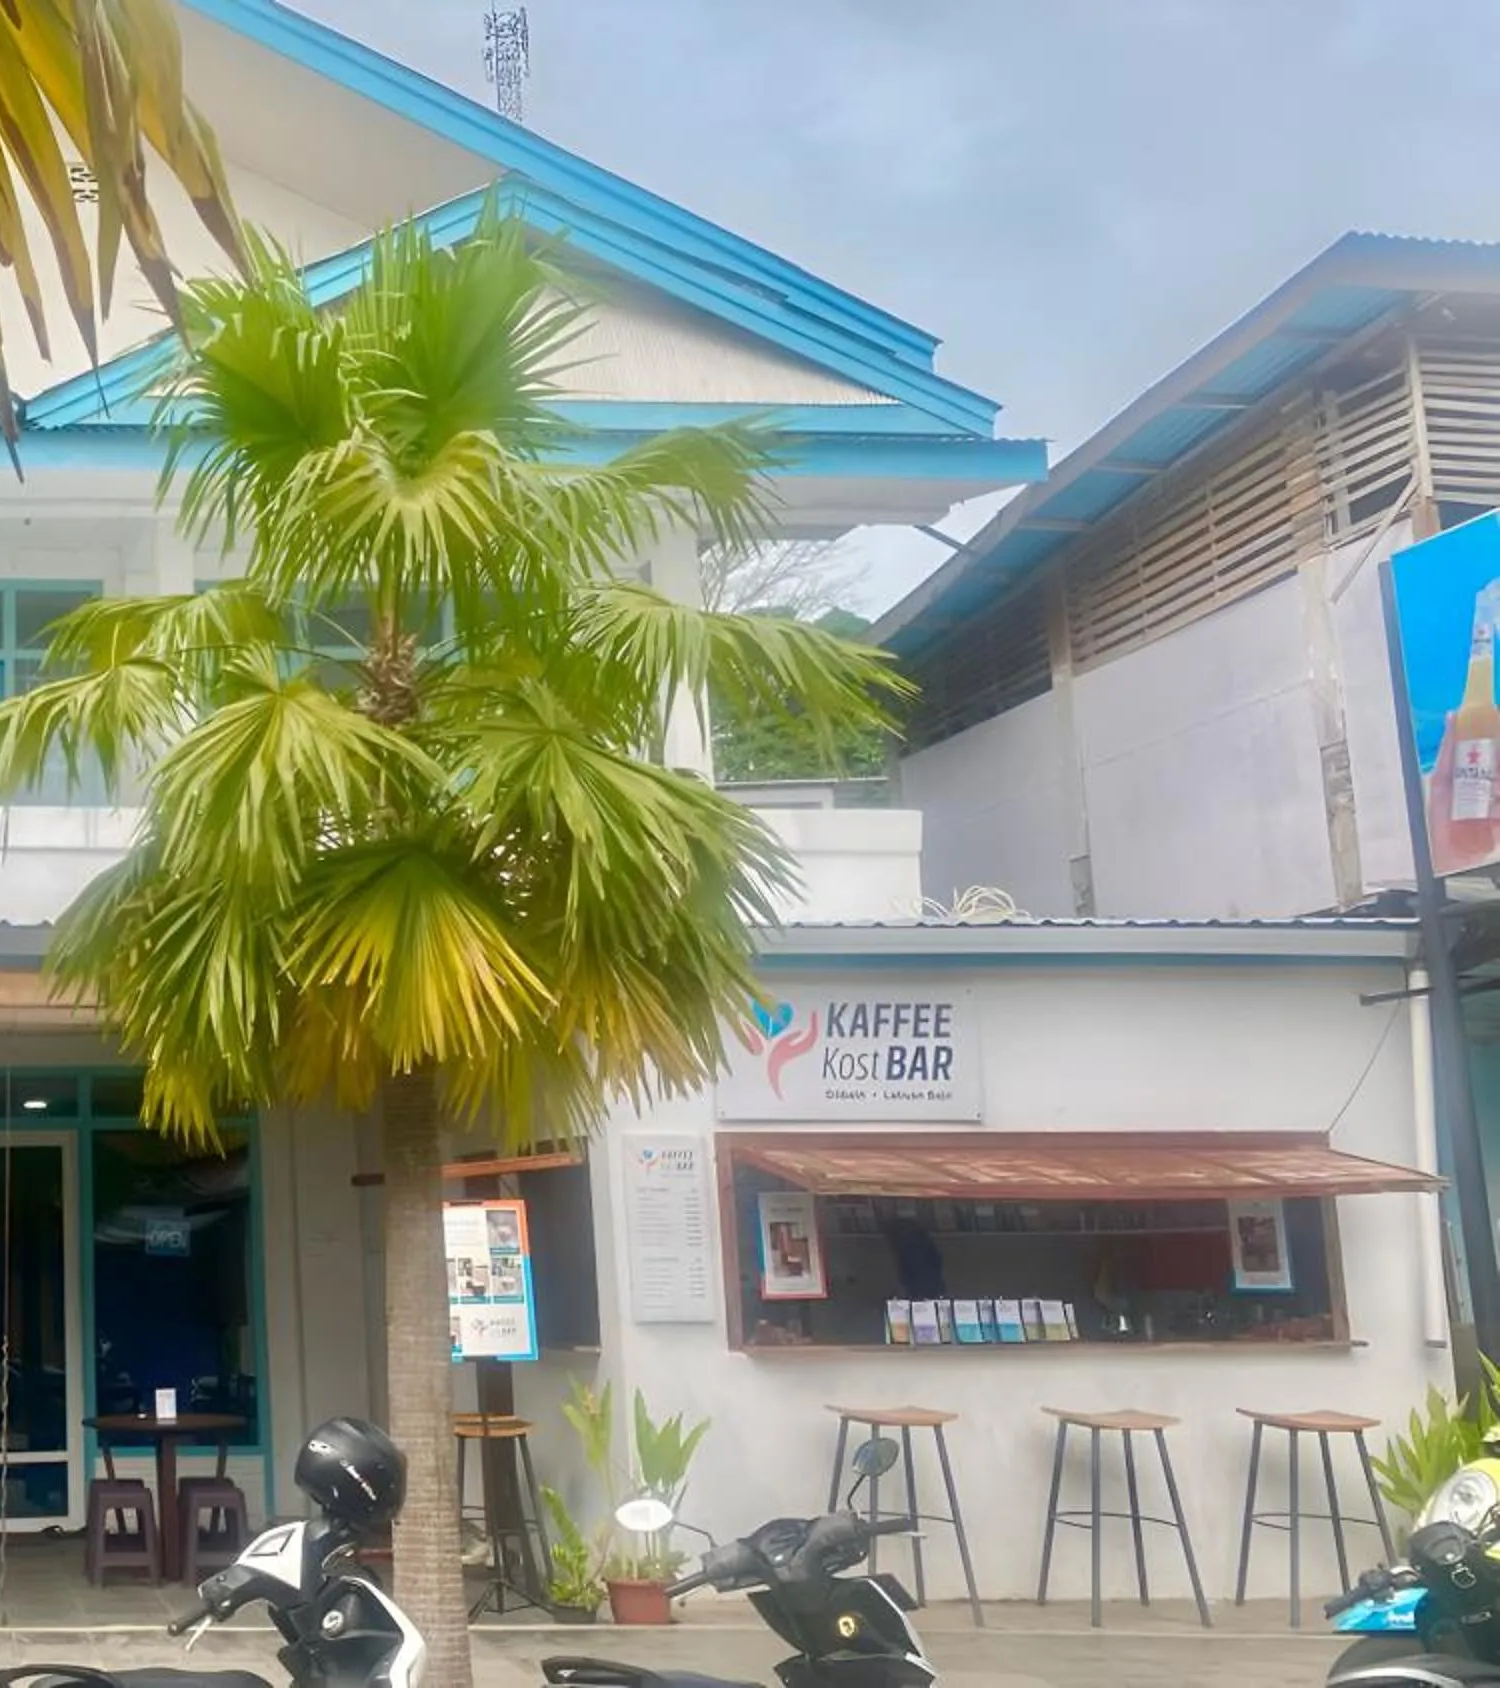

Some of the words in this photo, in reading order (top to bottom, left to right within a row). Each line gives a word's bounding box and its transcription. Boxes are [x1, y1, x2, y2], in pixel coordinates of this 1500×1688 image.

[826, 1003, 954, 1038] KAFFEE
[822, 1047, 879, 1081] Kost
[886, 1046, 954, 1081] BAR
